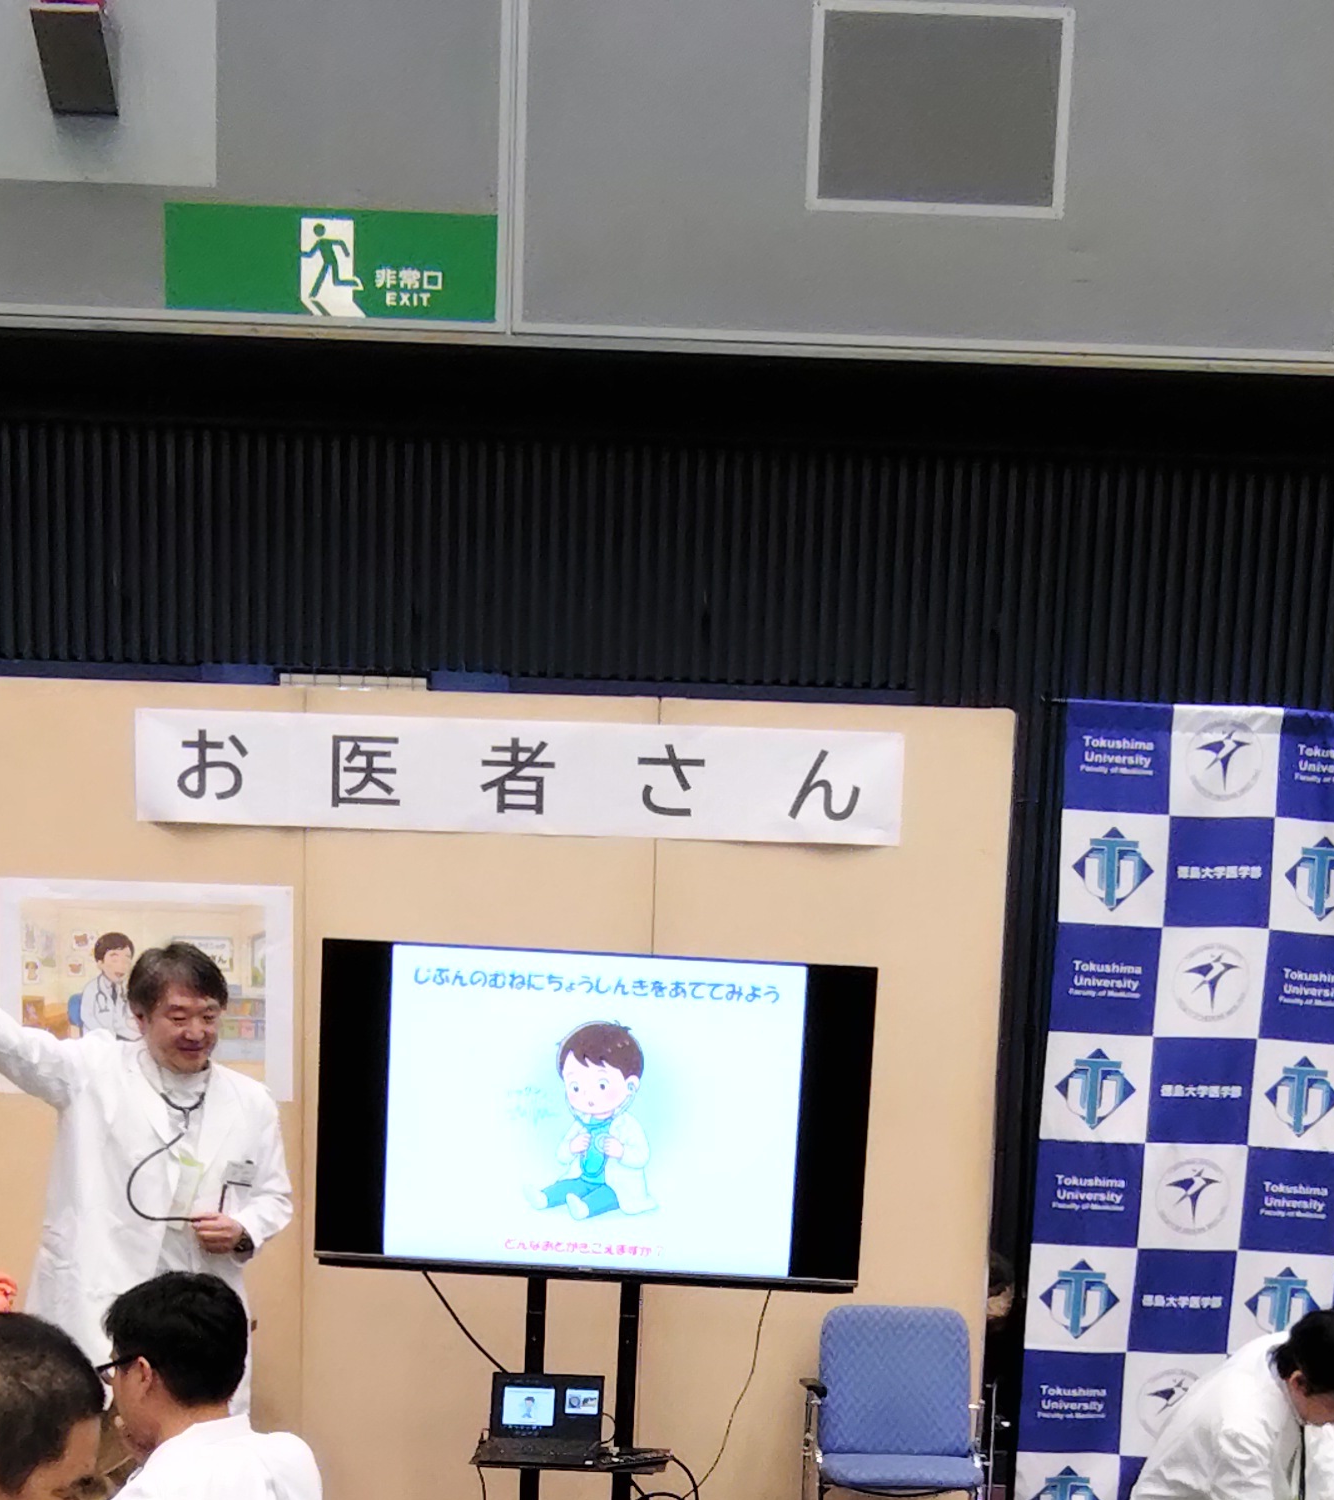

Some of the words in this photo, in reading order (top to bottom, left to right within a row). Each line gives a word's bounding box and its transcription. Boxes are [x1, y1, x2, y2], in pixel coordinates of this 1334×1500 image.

[375, 268, 442, 290] 非常口
[386, 292, 431, 306] EXIT
[1083, 736, 1154, 750] Tokushima
[1085, 751, 1151, 768] University
[177, 728, 861, 821] お医者さん
[1073, 960, 1142, 974] Tokushima
[414, 967, 781, 1003] じぶんのむねにちょうしんきをあててみよう
[1074, 975, 1139, 991] University
[1056, 1175, 1125, 1188] Tokushima
[1057, 1189, 1123, 1203] University
[1264, 1182, 1328, 1196] Tokushima
[1264, 1196, 1325, 1212] University
[1040, 1385, 1106, 1397] Tokushima
[1042, 1399, 1103, 1412] University
